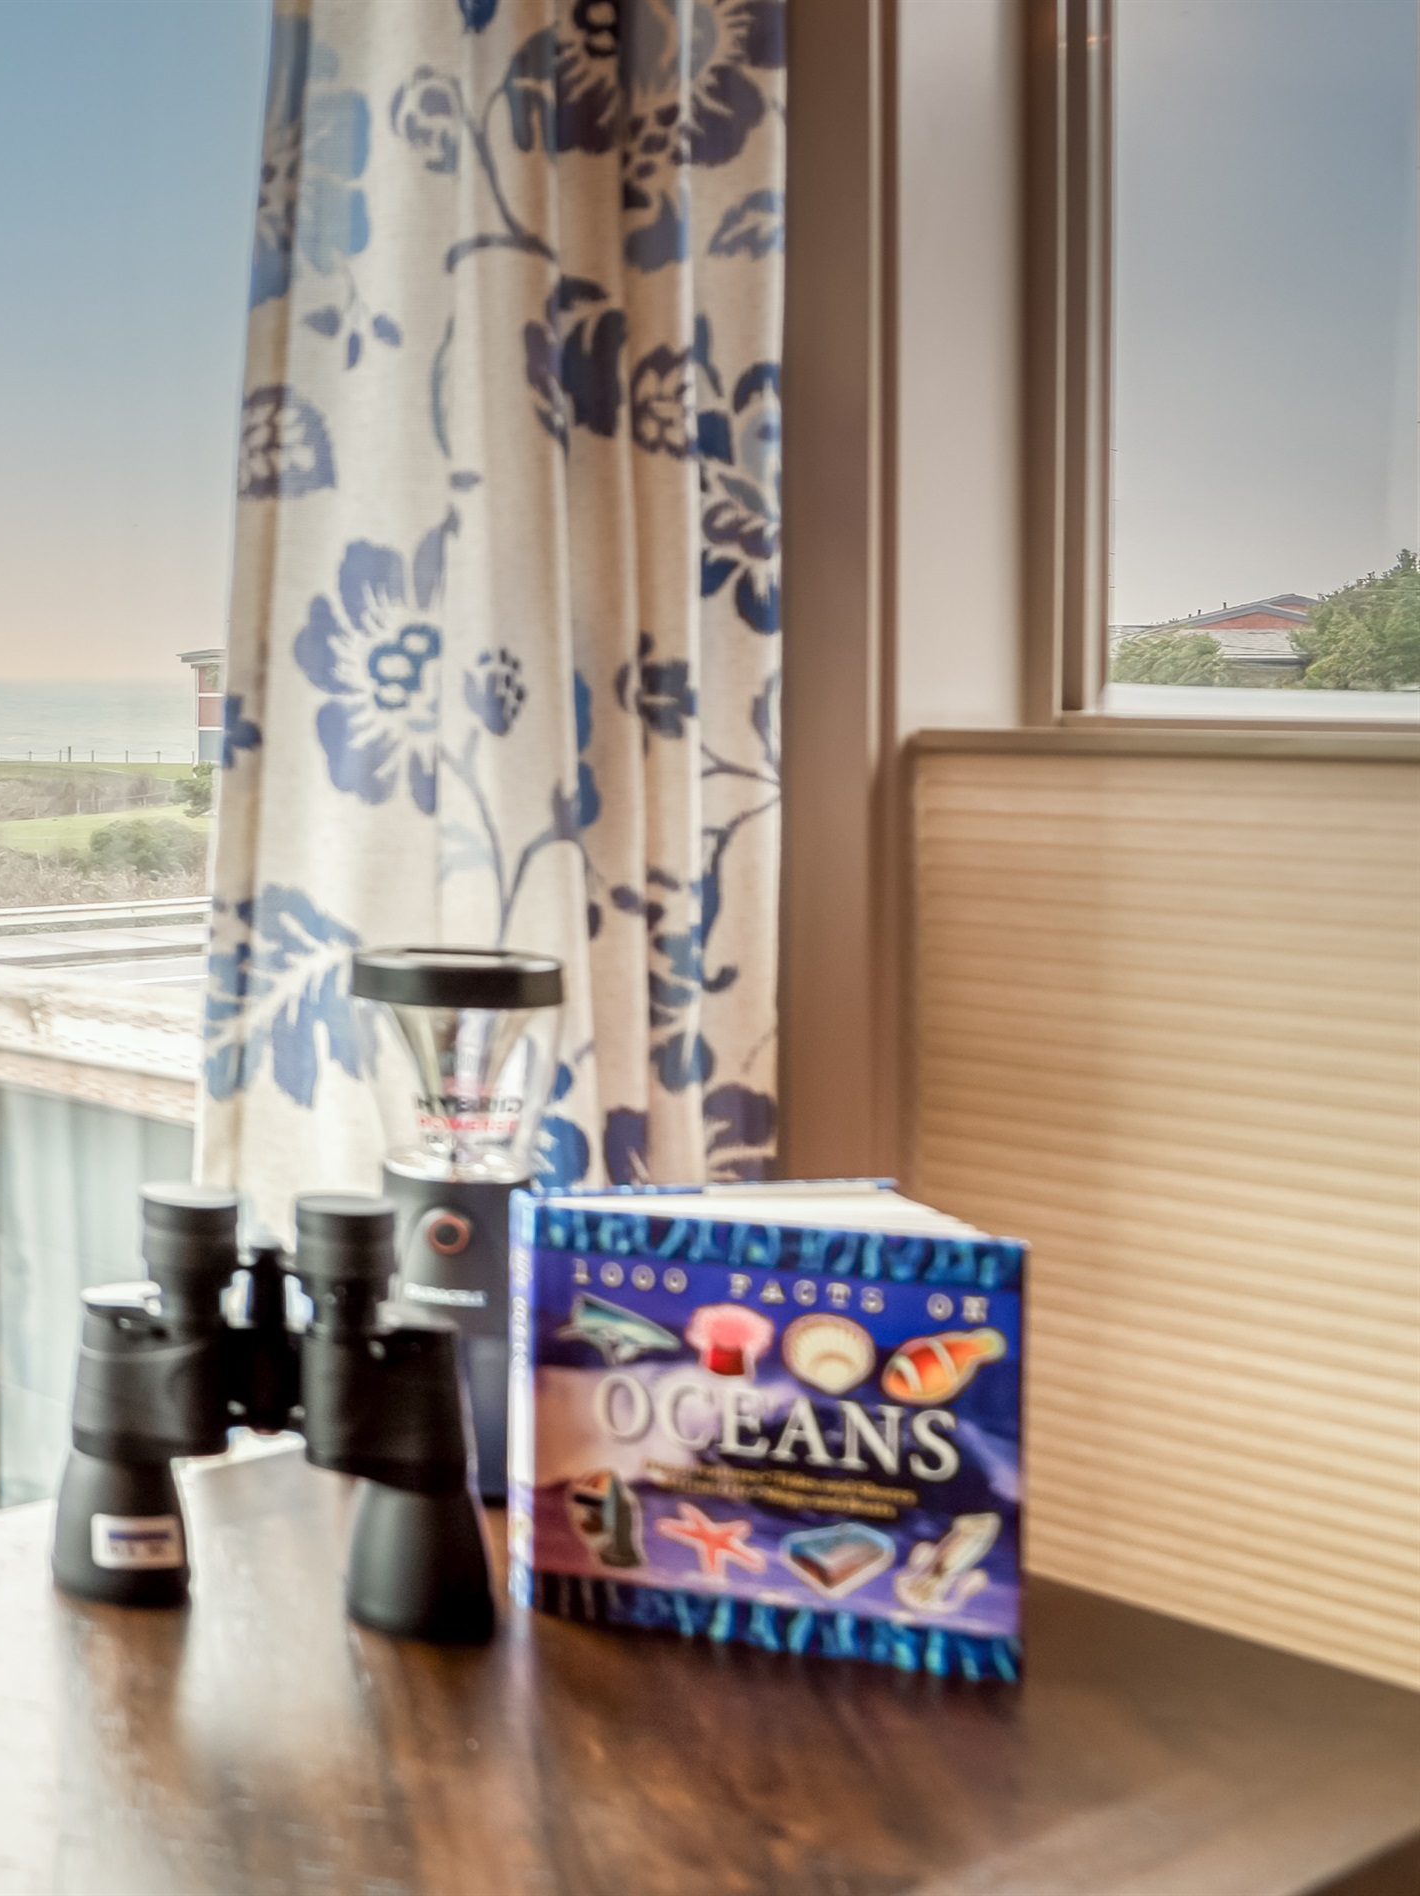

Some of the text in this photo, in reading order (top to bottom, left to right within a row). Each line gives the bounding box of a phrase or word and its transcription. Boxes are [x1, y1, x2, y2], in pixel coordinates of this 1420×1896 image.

[572, 1258, 688, 1294] 1000
[728, 1273, 885, 1314] FACTS
[926, 1293, 989, 1324] ON
[593, 1373, 960, 1482] OCEANS
